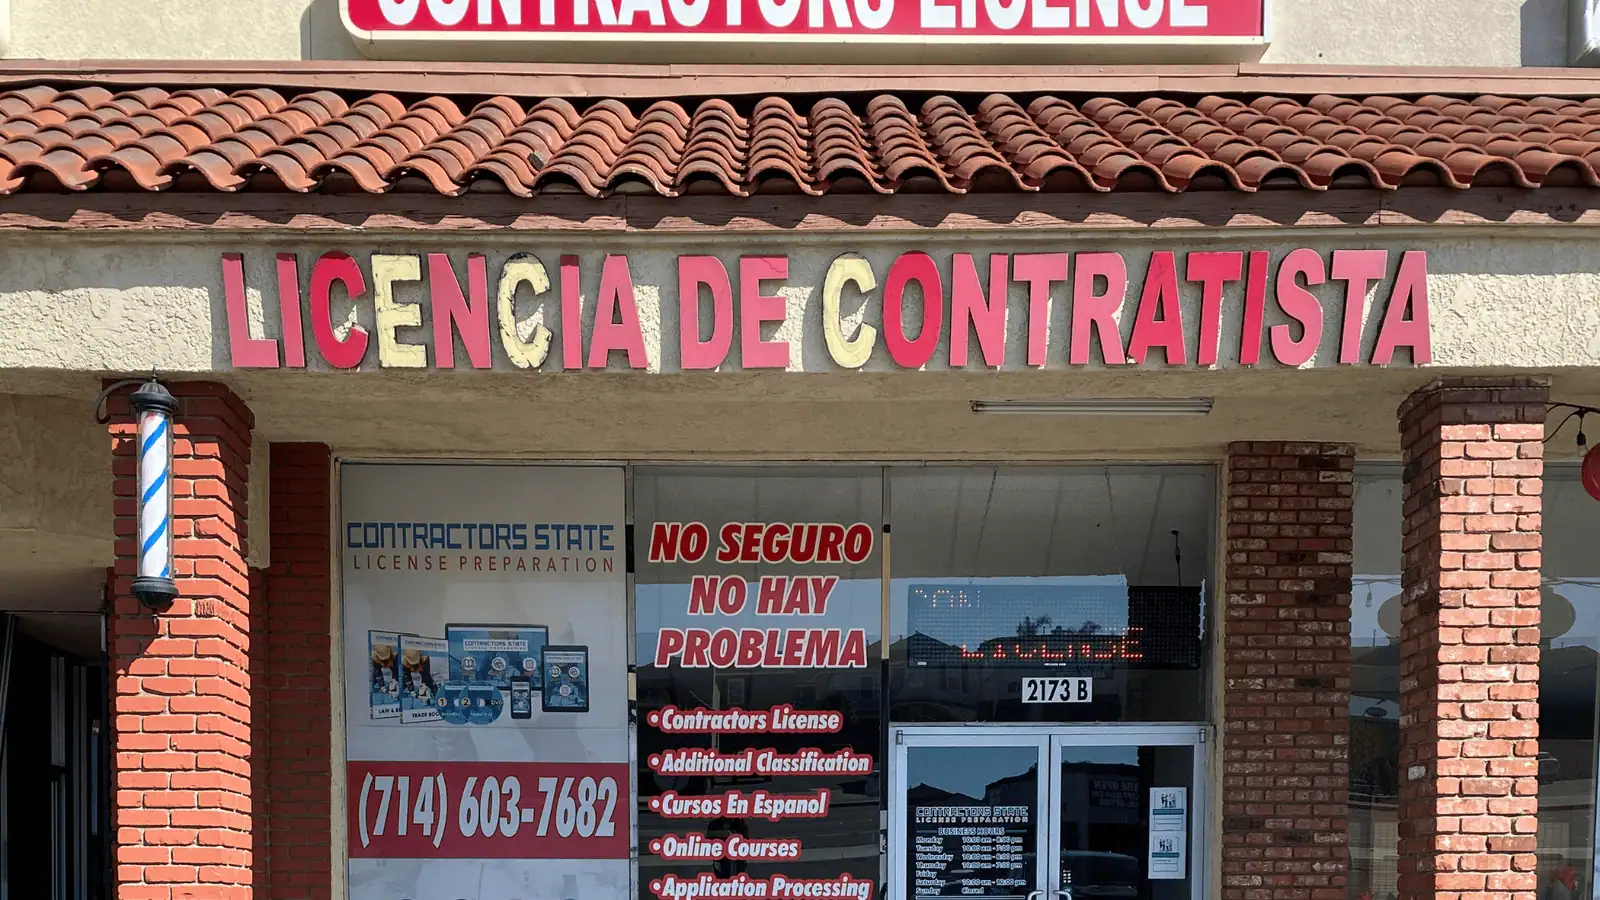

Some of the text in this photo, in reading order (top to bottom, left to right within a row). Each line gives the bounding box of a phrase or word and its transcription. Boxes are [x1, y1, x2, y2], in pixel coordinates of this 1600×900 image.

[221, 248, 1432, 369] LICENCIA DE CONTRATISTA
[347, 523, 614, 550] CONTRACTORS STATE
[648, 522, 874, 564] NO SEGURO
[354, 554, 613, 572] LICENSE PREPARATION
[687, 575, 839, 616] NO HAY
[654, 627, 867, 669] PROBLEMA
[1027, 679, 1088, 701] 2173 B
[662, 708, 839, 729] Contractors License
[661, 751, 869, 772] Additional Classification
[358, 771, 618, 849] (714) 603-7682
[662, 792, 827, 818] Cursos En Espanol
[916, 806, 1028, 817] CONTRACTORS STATE
[916, 836, 943, 844] Monday
[938, 827, 1005, 835] BUSINESS HOURS
[663, 836, 798, 857] Online Courses
[916, 845, 943, 853] Tuesday
[916, 853, 954, 861] Wednesday
[916, 862, 947, 870] Thursday
[916, 870, 937, 878] Friday
[662, 876, 870, 900] Application Processing
[916, 879, 946, 887] Saturday
[916, 887, 941, 895] Sunday
